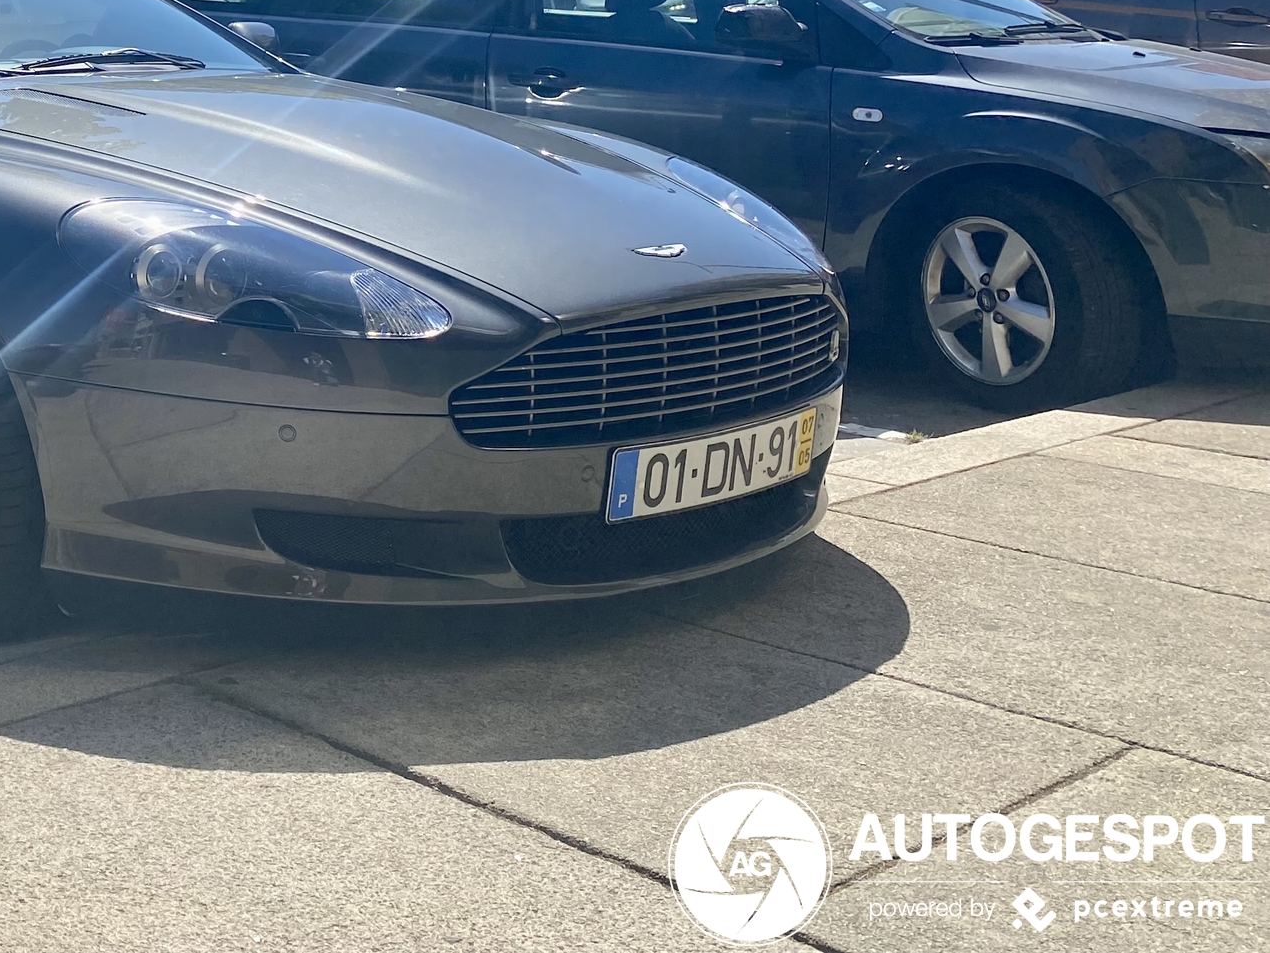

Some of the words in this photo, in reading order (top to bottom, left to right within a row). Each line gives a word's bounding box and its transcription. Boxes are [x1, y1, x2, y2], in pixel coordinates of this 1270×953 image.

[801, 415, 815, 435] 07
[797, 447, 811, 467] 05
[617, 493, 627, 509] P
